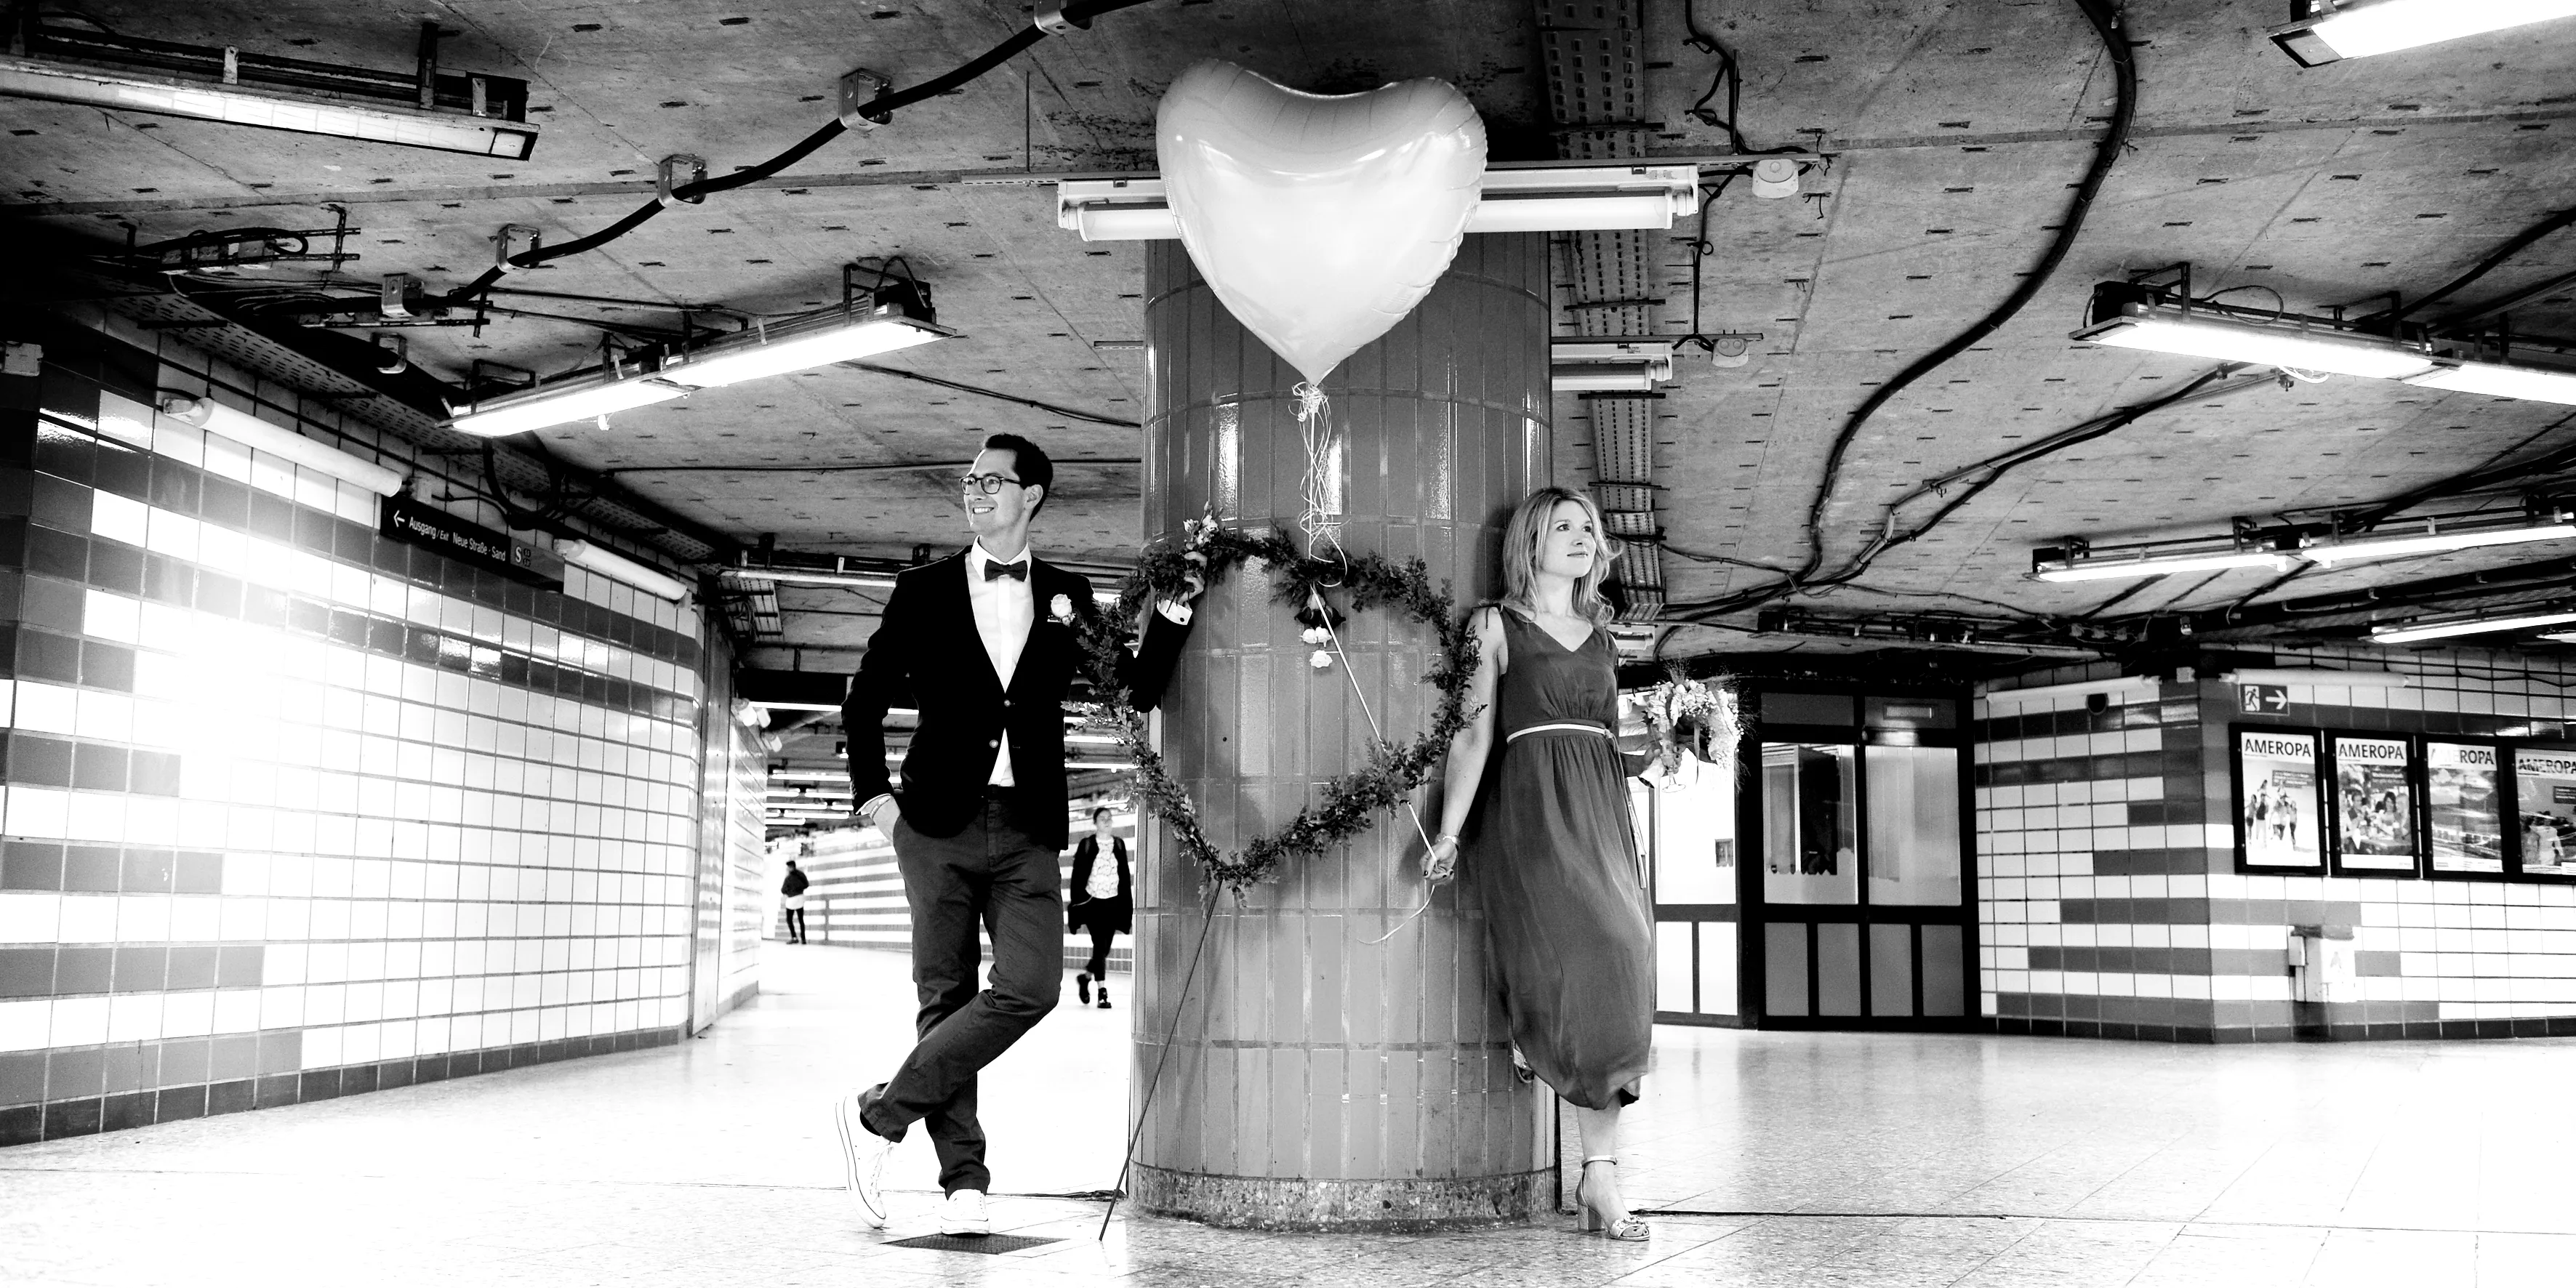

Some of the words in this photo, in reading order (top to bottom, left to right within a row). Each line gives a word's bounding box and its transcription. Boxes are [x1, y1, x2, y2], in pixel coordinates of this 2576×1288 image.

[409, 516, 436, 539] Ausgang
[440, 530, 449, 542] Exit
[453, 532, 468, 548] Neue
[469, 538, 488, 555] Straße
[491, 546, 506, 561] Sand
[2244, 738, 2311, 757] AMEROPA
[2338, 744, 2404, 760] AMEROPA
